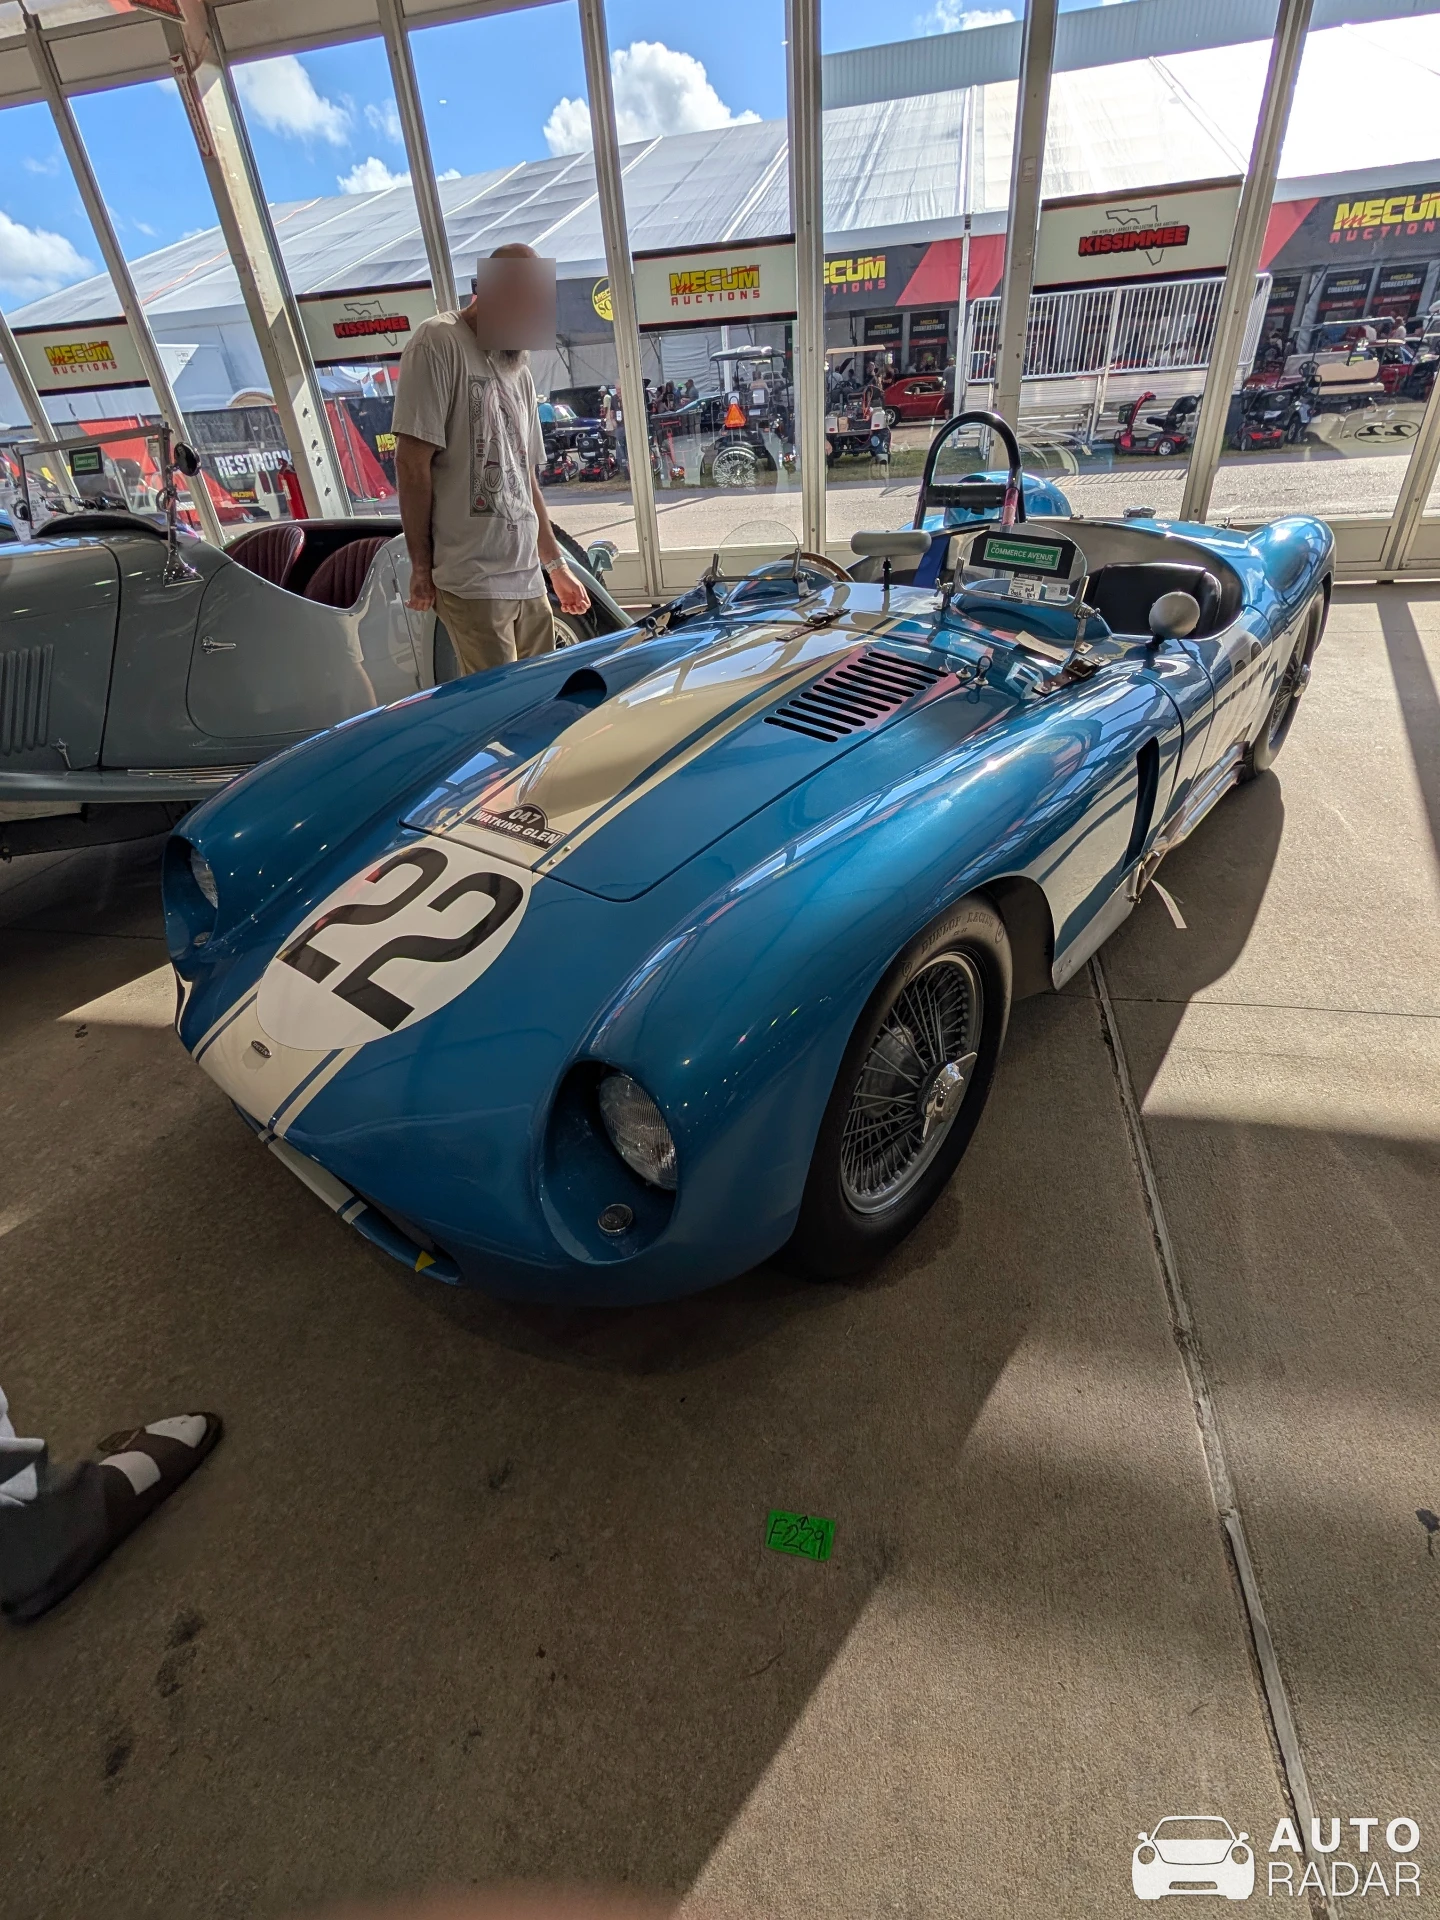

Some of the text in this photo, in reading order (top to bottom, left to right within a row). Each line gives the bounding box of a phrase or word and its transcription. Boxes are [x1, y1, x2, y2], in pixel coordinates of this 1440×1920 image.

[1078, 225, 1190, 257] KISSIMMEE
[669, 265, 760, 296] MECUM
[830, 279, 886, 295] TIONS
[671, 290, 760, 306] AUCTIONS
[333, 315, 411, 338] KISSIMMEE
[44, 341, 114, 366] MECUM
[52, 361, 118, 375] AUCTIONS
[990, 547, 1054, 562] COMMERCE AVENUE
[472, 810, 524, 833] WATKINS
[523, 827, 561, 844] GLEN
[508, 808, 542, 824] 047
[277, 846, 524, 1032] 22
[921, 915, 961, 955] DUNLOP
